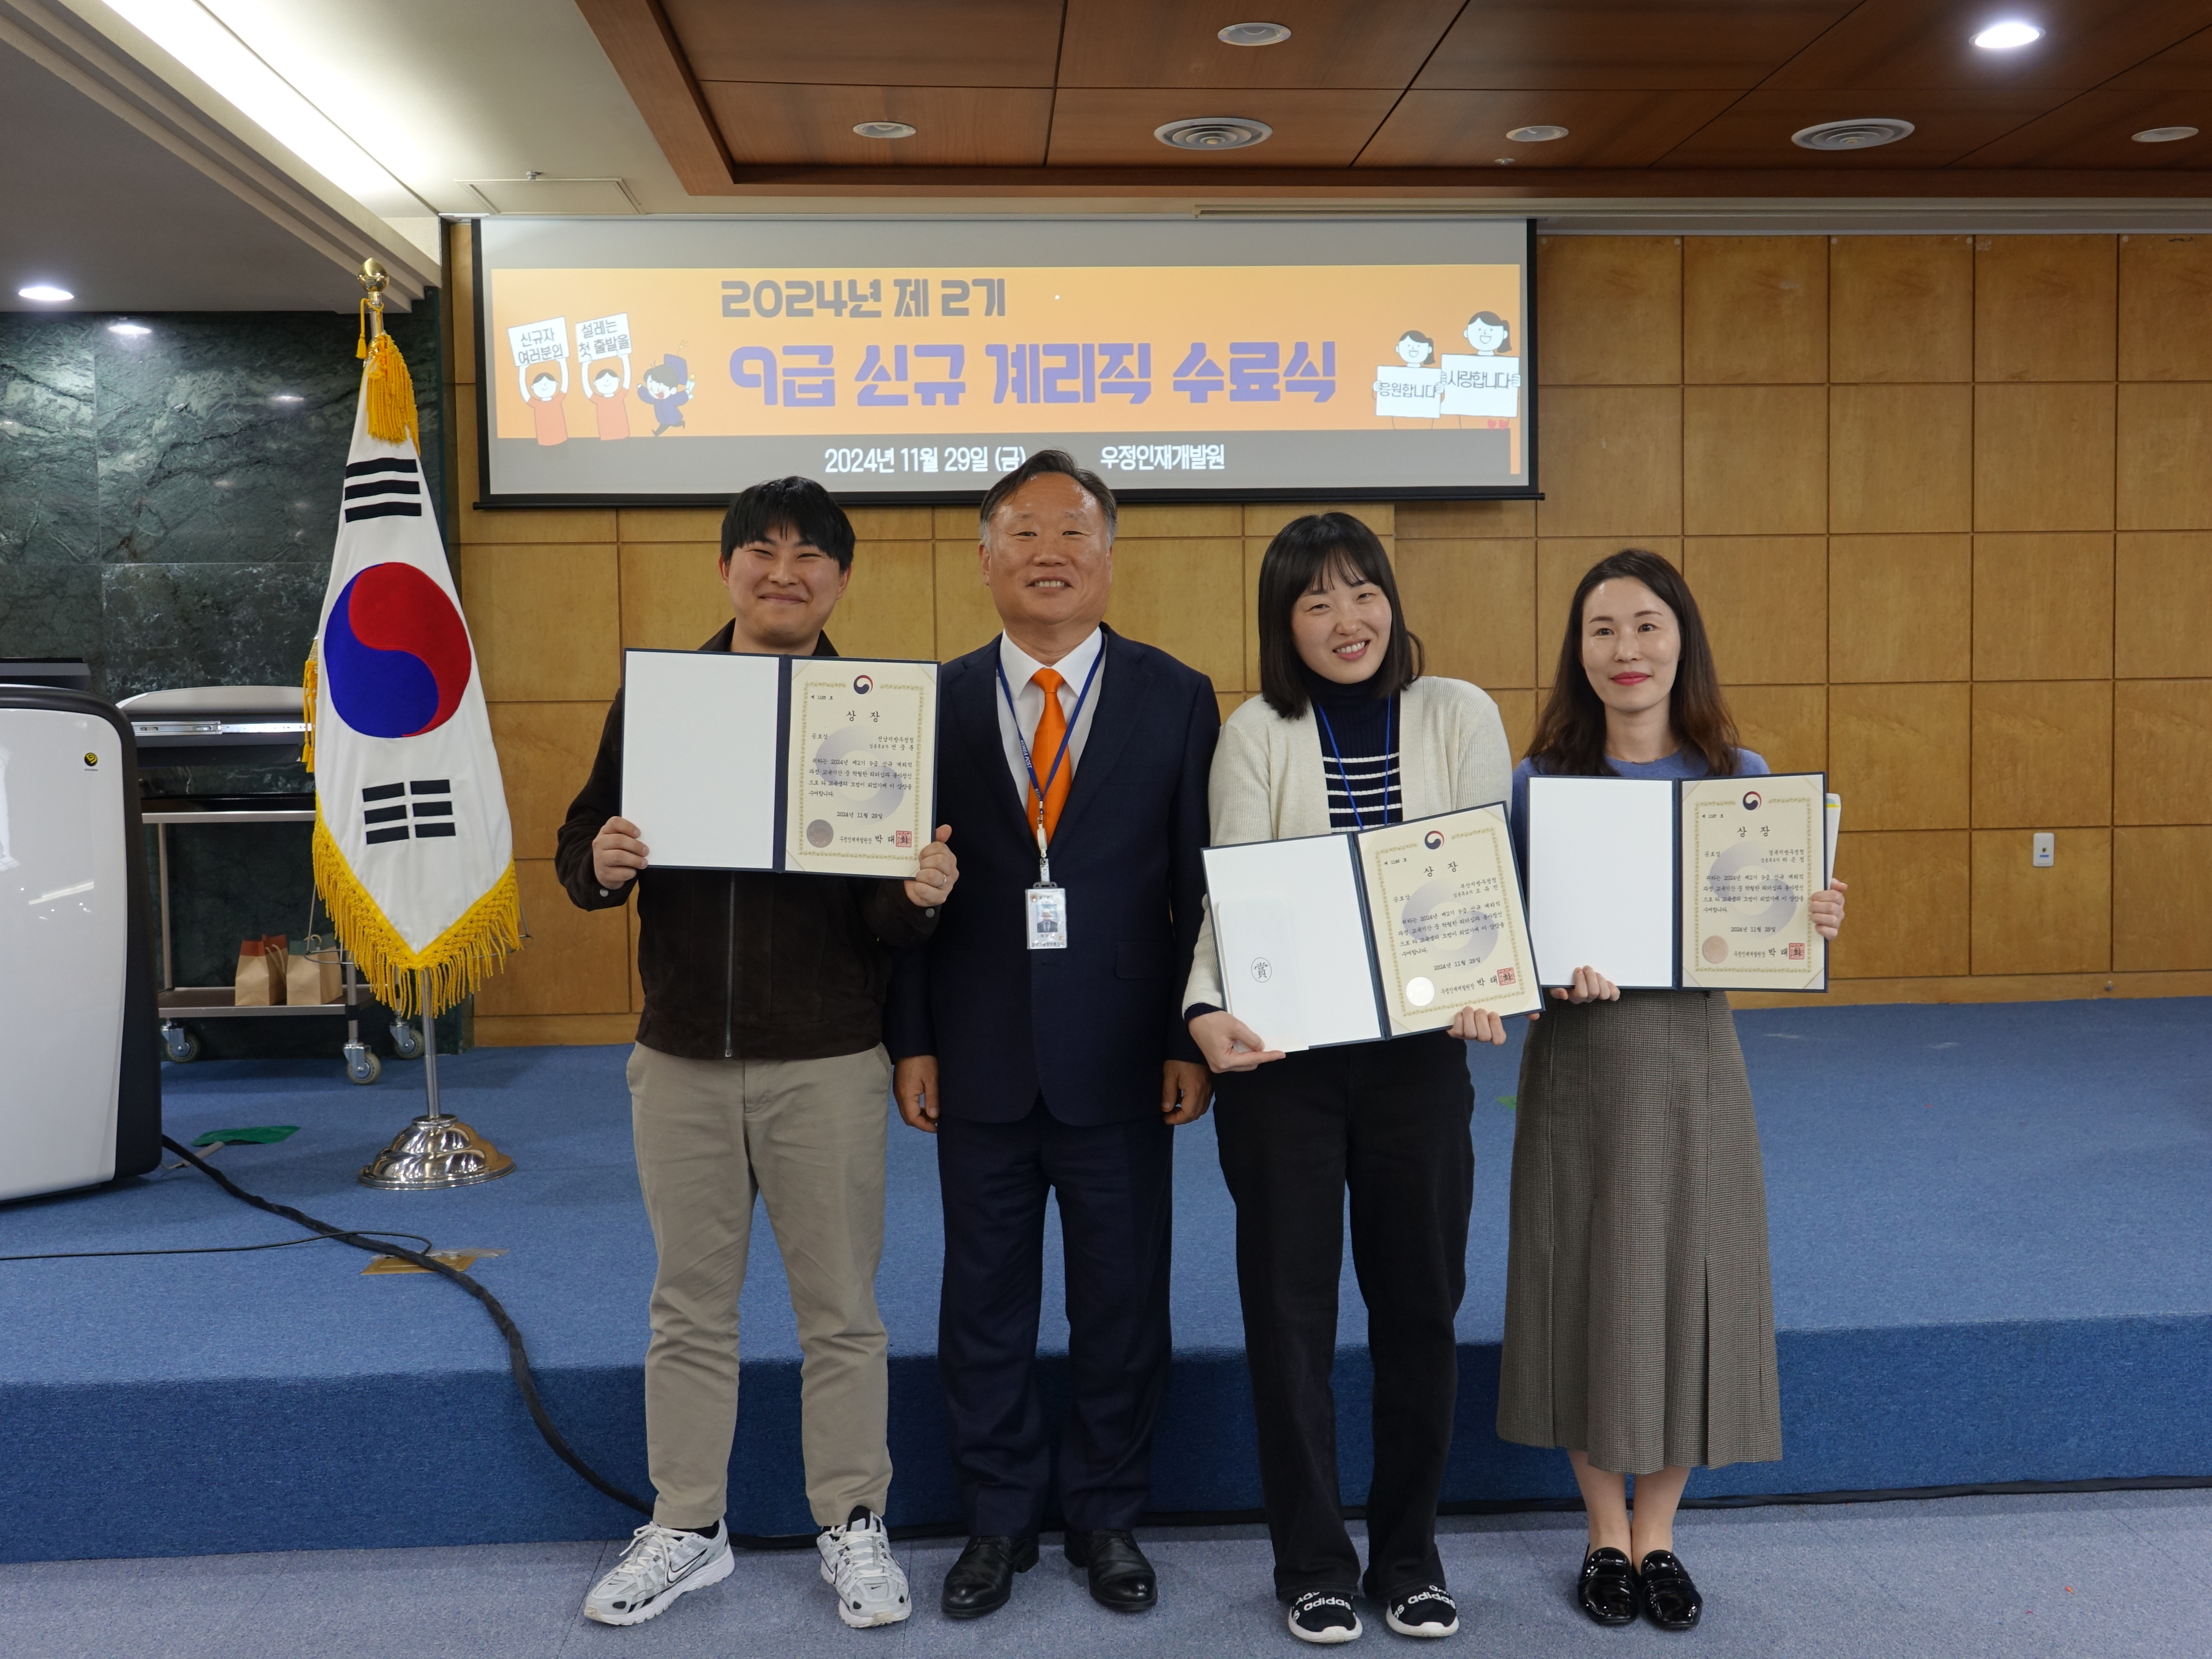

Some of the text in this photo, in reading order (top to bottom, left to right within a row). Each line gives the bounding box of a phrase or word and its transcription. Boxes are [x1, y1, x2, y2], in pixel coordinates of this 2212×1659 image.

[722, 278, 1005, 318] 2024년 제 2기
[521, 327, 554, 347] 신규자
[582, 320, 617, 338] 설레는
[518, 343, 563, 364] 여러분의
[579, 335, 629, 357] 첫 출발을
[729, 341, 1336, 407] 9급 신규 계리직 수료식
[1447, 370, 1512, 389] 사랑합니다
[1380, 383, 1436, 398] 응원합니다
[825, 447, 894, 473] 2024년
[900, 447, 939, 472] 11월
[945, 446, 988, 472] 29일
[1101, 444, 1225, 471] 우정인재개발원
[846, 710, 880, 722] 상 장
[875, 834, 883, 844] 박
[888, 835, 894, 844] 태
[1737, 826, 1770, 837] 상 장
[1424, 862, 1458, 877] 상 장
[1393, 894, 1410, 903] 공로상
[1412, 925, 1432, 934] 교육기간
[1460, 916, 1481, 924] 리더십과
[1420, 913, 1438, 922] 2024년
[1420, 934, 1439, 943] 교육생의
[1460, 927, 1479, 936] 되었기에
[1768, 948, 1776, 957] 박
[1781, 948, 1788, 957] 태
[1255, 962, 1269, 979] 賞
[1476, 977, 1485, 987] 박
[1490, 975, 1497, 985] 태
[1304, 1597, 1351, 1610] adidas
[1408, 1592, 1456, 1609] adidas
